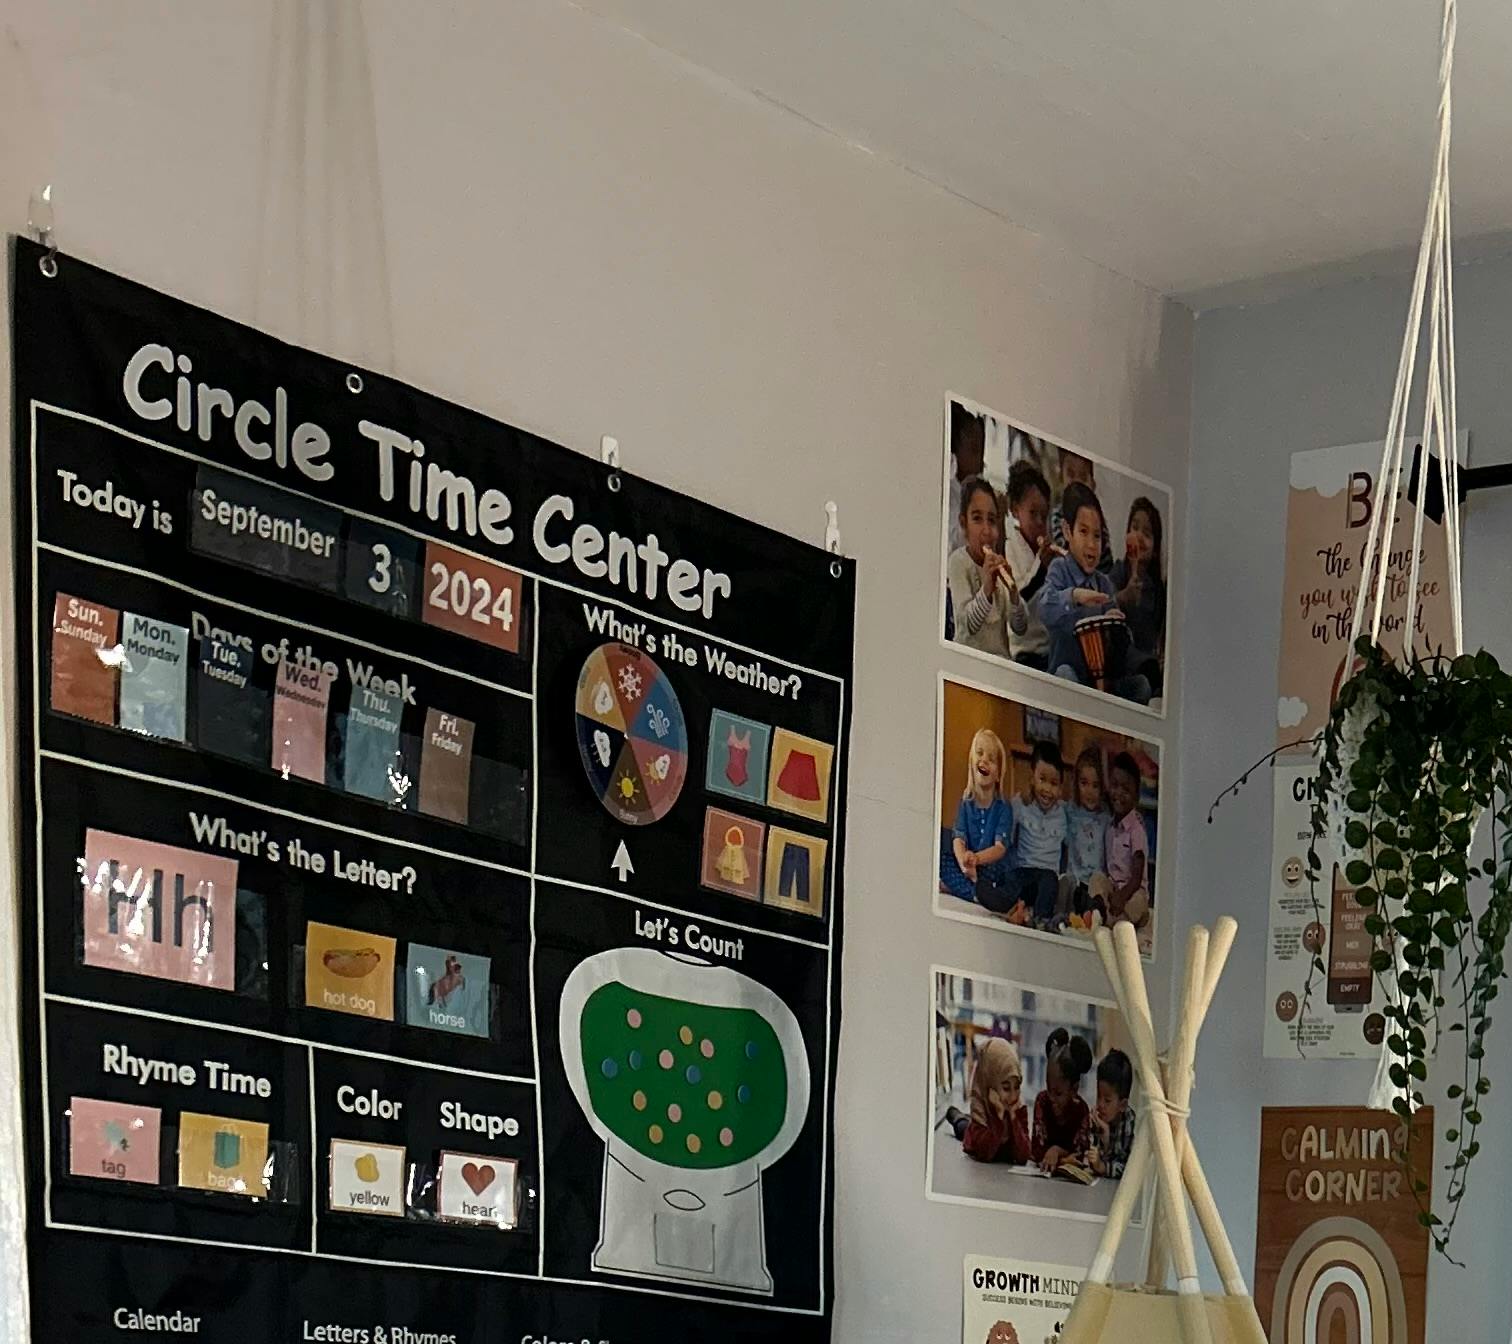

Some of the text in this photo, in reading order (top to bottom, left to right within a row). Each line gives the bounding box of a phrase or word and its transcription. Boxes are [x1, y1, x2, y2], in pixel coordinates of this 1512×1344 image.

[123, 344, 731, 618] Circle Time Center
[57, 469, 513, 632] Today is September 3 2024
[1317, 542, 1352, 578] the
[67, 600, 103, 626] Sun.
[1300, 589, 1334, 620] you
[61, 619, 108, 646] Sunday
[133, 617, 176, 645] Mon.
[1312, 621, 1330, 645] in
[1326, 607, 1355, 642] th
[128, 639, 180, 664] Monday
[212, 641, 241, 668] Tue.
[583, 603, 801, 700] What's the Weather?
[202, 660, 247, 689] Tuesday
[261, 638, 289, 664] of
[295, 646, 338, 682] the
[346, 658, 417, 706] Week
[285, 664, 321, 692] Wed.
[363, 690, 391, 714] Thu.
[351, 708, 398, 734] Thursday
[439, 714, 459, 737] Fri.
[431, 732, 463, 756] Friday
[190, 811, 416, 894] What's the Letter?
[635, 910, 745, 960] Let's Count
[323, 989, 376, 1016] hot dog
[429, 1009, 466, 1028] horse
[103, 1044, 272, 1098] Rhyme Time
[336, 1085, 402, 1120] Color
[440, 1101, 519, 1140] Shape
[101, 1158, 126, 1178] tag
[349, 1188, 390, 1208] yellow
[1285, 1169, 1402, 1204] CORNER
[973, 1267, 1040, 1294] GROWTH
[114, 1307, 202, 1333] Calendar
